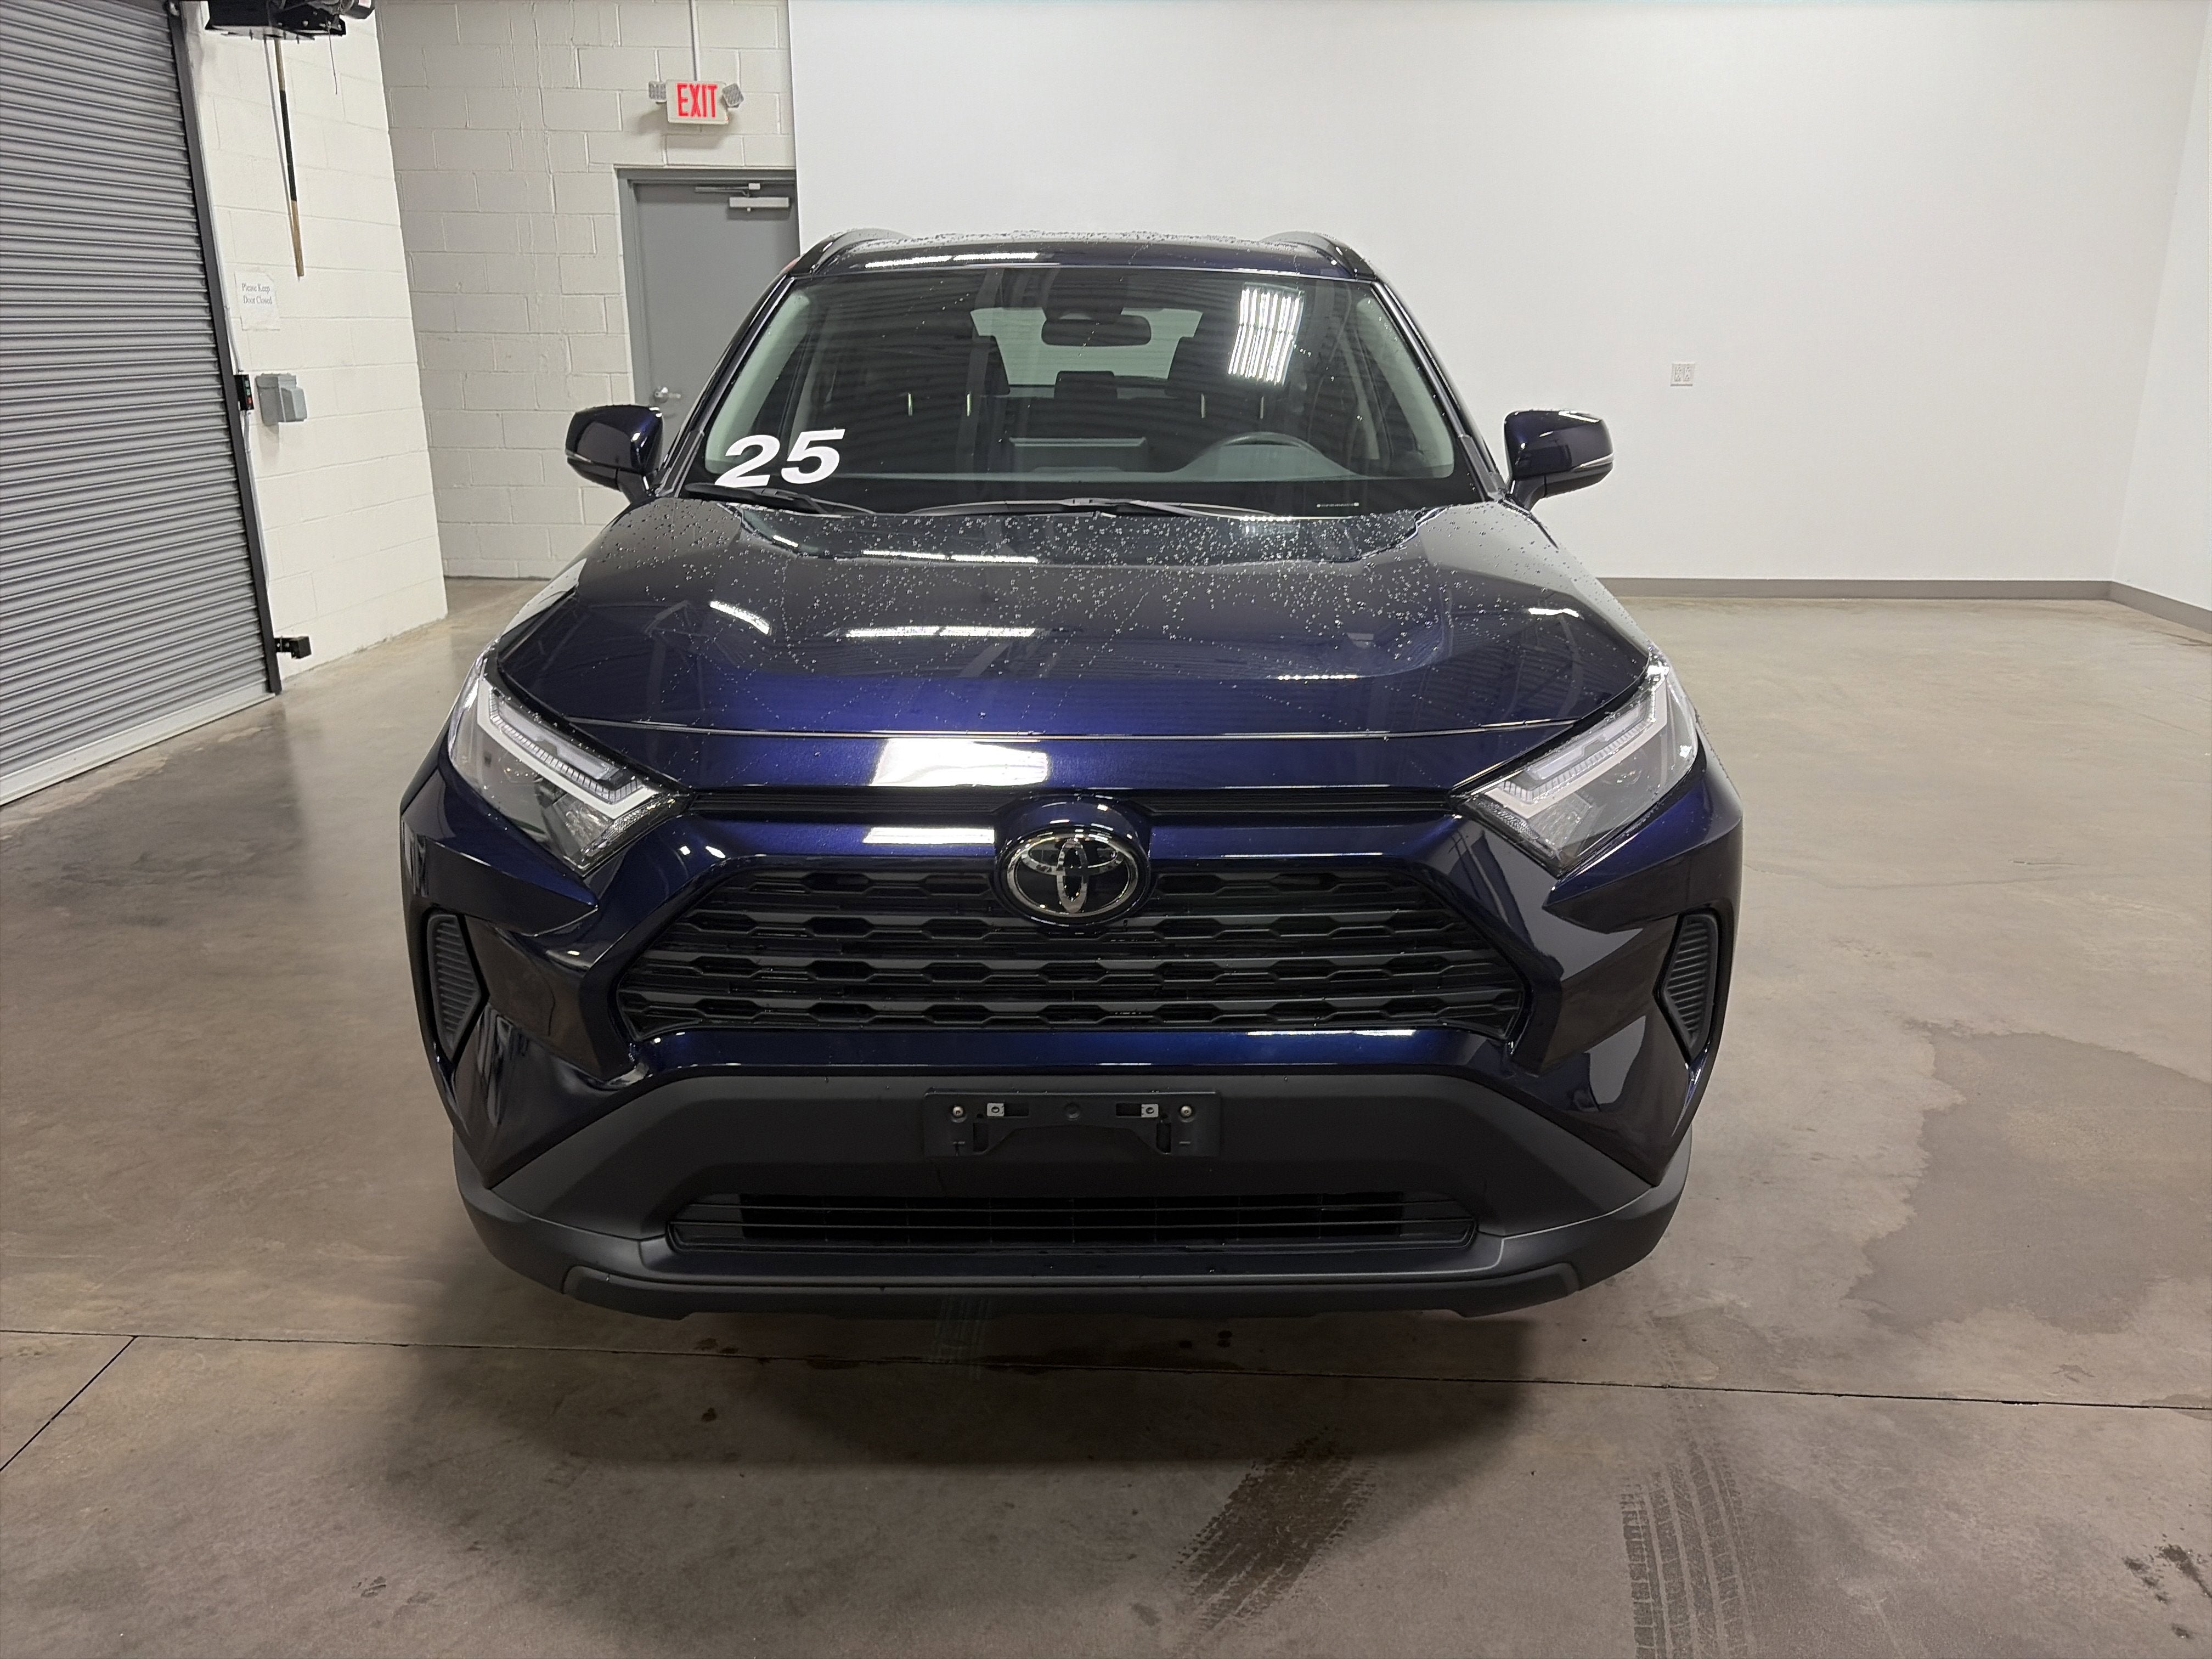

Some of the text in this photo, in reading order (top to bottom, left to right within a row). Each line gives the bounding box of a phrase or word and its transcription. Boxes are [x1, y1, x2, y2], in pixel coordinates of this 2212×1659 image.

[676, 83, 718, 118] EXIT
[242, 283, 270, 295] Please Keep
[243, 295, 273, 304] Door Closed
[714, 428, 845, 488] 25
